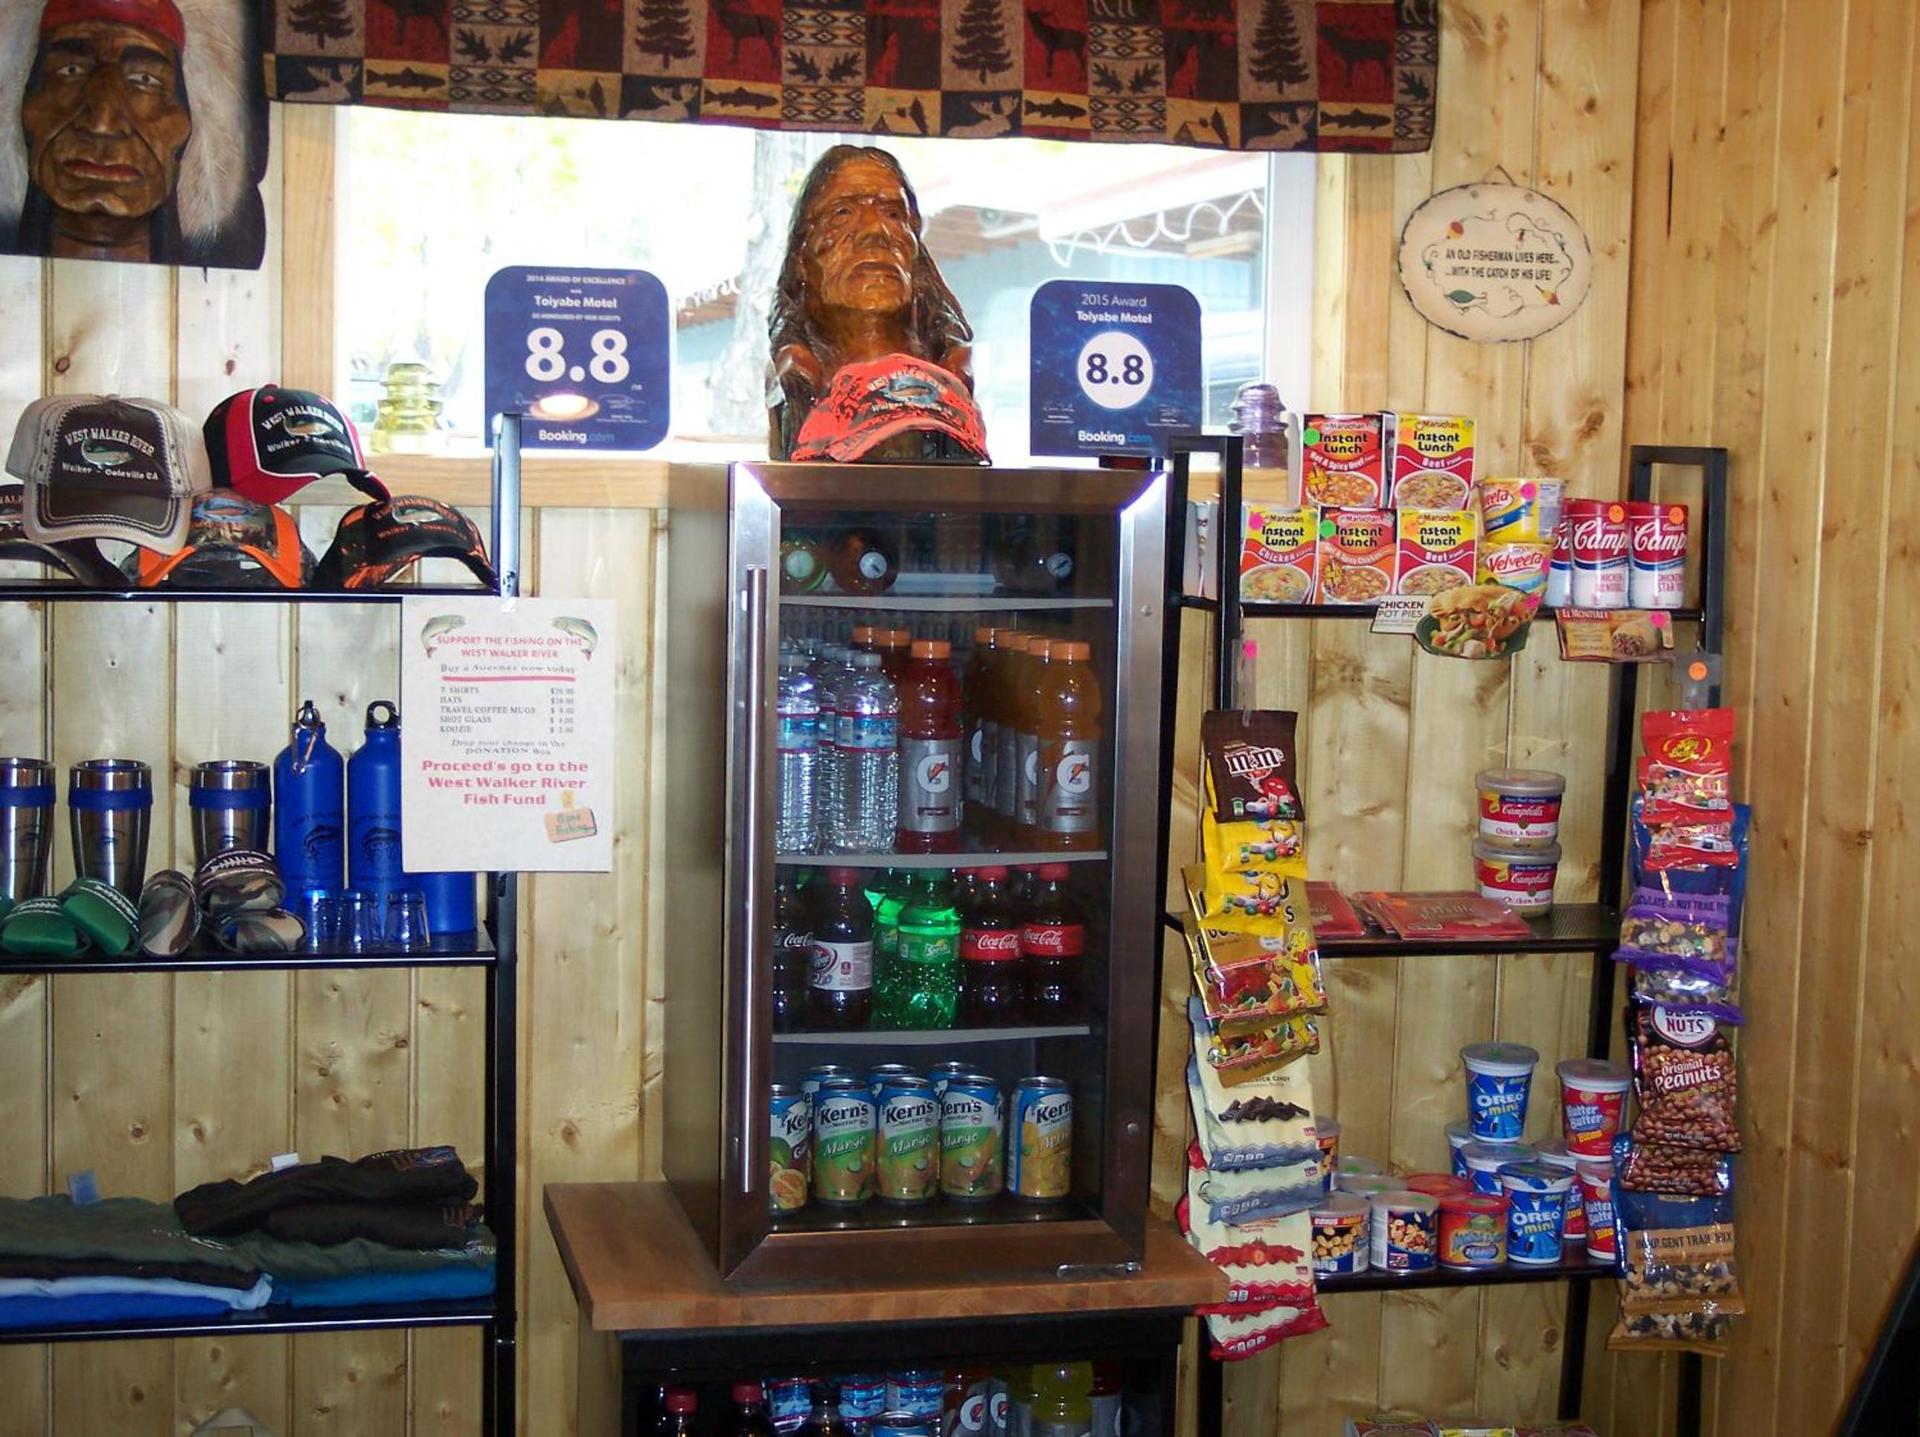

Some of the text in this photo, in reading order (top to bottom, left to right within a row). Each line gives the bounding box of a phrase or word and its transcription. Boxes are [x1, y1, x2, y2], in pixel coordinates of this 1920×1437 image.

[1446, 248, 1455, 259] AN
[1457, 249, 1471, 260] OLD
[1473, 250, 1513, 262] FISHERMAN
[1514, 252, 1534, 262] LIVES
[1472, 267, 1484, 278] THE
[1487, 268, 1508, 278] CATCH
[1510, 268, 1520, 278] OF
[1522, 270, 1534, 280] HIS
[545, 275, 571, 284] AWARD
[582, 276, 626, 286] EXCELLENCE
[534, 295, 617, 308] Toiyabe Motel
[1081, 293, 1147, 307] 2015 Award
[1076, 311, 1152, 324] Toiyabe Motel
[526, 327, 630, 383] 8.8
[1086, 353, 1144, 385] 8.8
[262, 412, 286, 430] WEST
[1422, 420, 1459, 429] Maruchan
[64, 427, 155, 457] WEST WALKER RIVER
[1320, 433, 1368, 444] Instant
[1414, 431, 1460, 442] Instant
[1324, 444, 1362, 454] Lunch
[1418, 442, 1454, 452] Lunch
[62, 462, 93, 474] Walker
[1422, 457, 1445, 468] Beef
[1424, 514, 1460, 522] Maruchan
[1262, 526, 1304, 536] Instant
[1336, 525, 1382, 537] Instant
[1420, 526, 1462, 536] nstant
[1266, 536, 1298, 546] Lunch
[1340, 537, 1378, 547] Lunch
[1420, 536, 1456, 546] Lunch
[1258, 548, 1296, 562] Chicken
[1426, 552, 1447, 562] Beef
[1489, 552, 1543, 572] Velveeta
[1380, 601, 1424, 609] CHICKEN
[1378, 610, 1423, 618] POT PIES
[437, 636, 582, 646] SUPPORT THE FISHING ON THE
[461, 649, 558, 658] WEST WALKER RIVER
[440, 706, 472, 714] TRAVEL
[474, 706, 508, 714] COFFEE
[510, 706, 536, 714] MUGS
[440, 716, 462, 724] SHOT
[464, 716, 492, 724] GLASS
[422, 760, 589, 774] Proceed's go to the
[428, 777, 587, 788] West Walker River
[464, 794, 546, 805] Fish Fund
[1666, 1018, 1705, 1034] NUTS
[1662, 1058, 1704, 1077] Original
[1654, 1064, 1722, 1093] Peanuts
[1477, 1093, 1524, 1108] OREO
[820, 1102, 868, 1126] Kern's
[886, 1100, 934, 1124] Kern's
[1489, 1103, 1519, 1116] mini
[1570, 1114, 1604, 1129] Butter
[824, 1136, 866, 1157] Mango
[891, 1134, 932, 1154] Mango
[1512, 1210, 1560, 1225] OREO
[1524, 1221, 1554, 1234] mini
